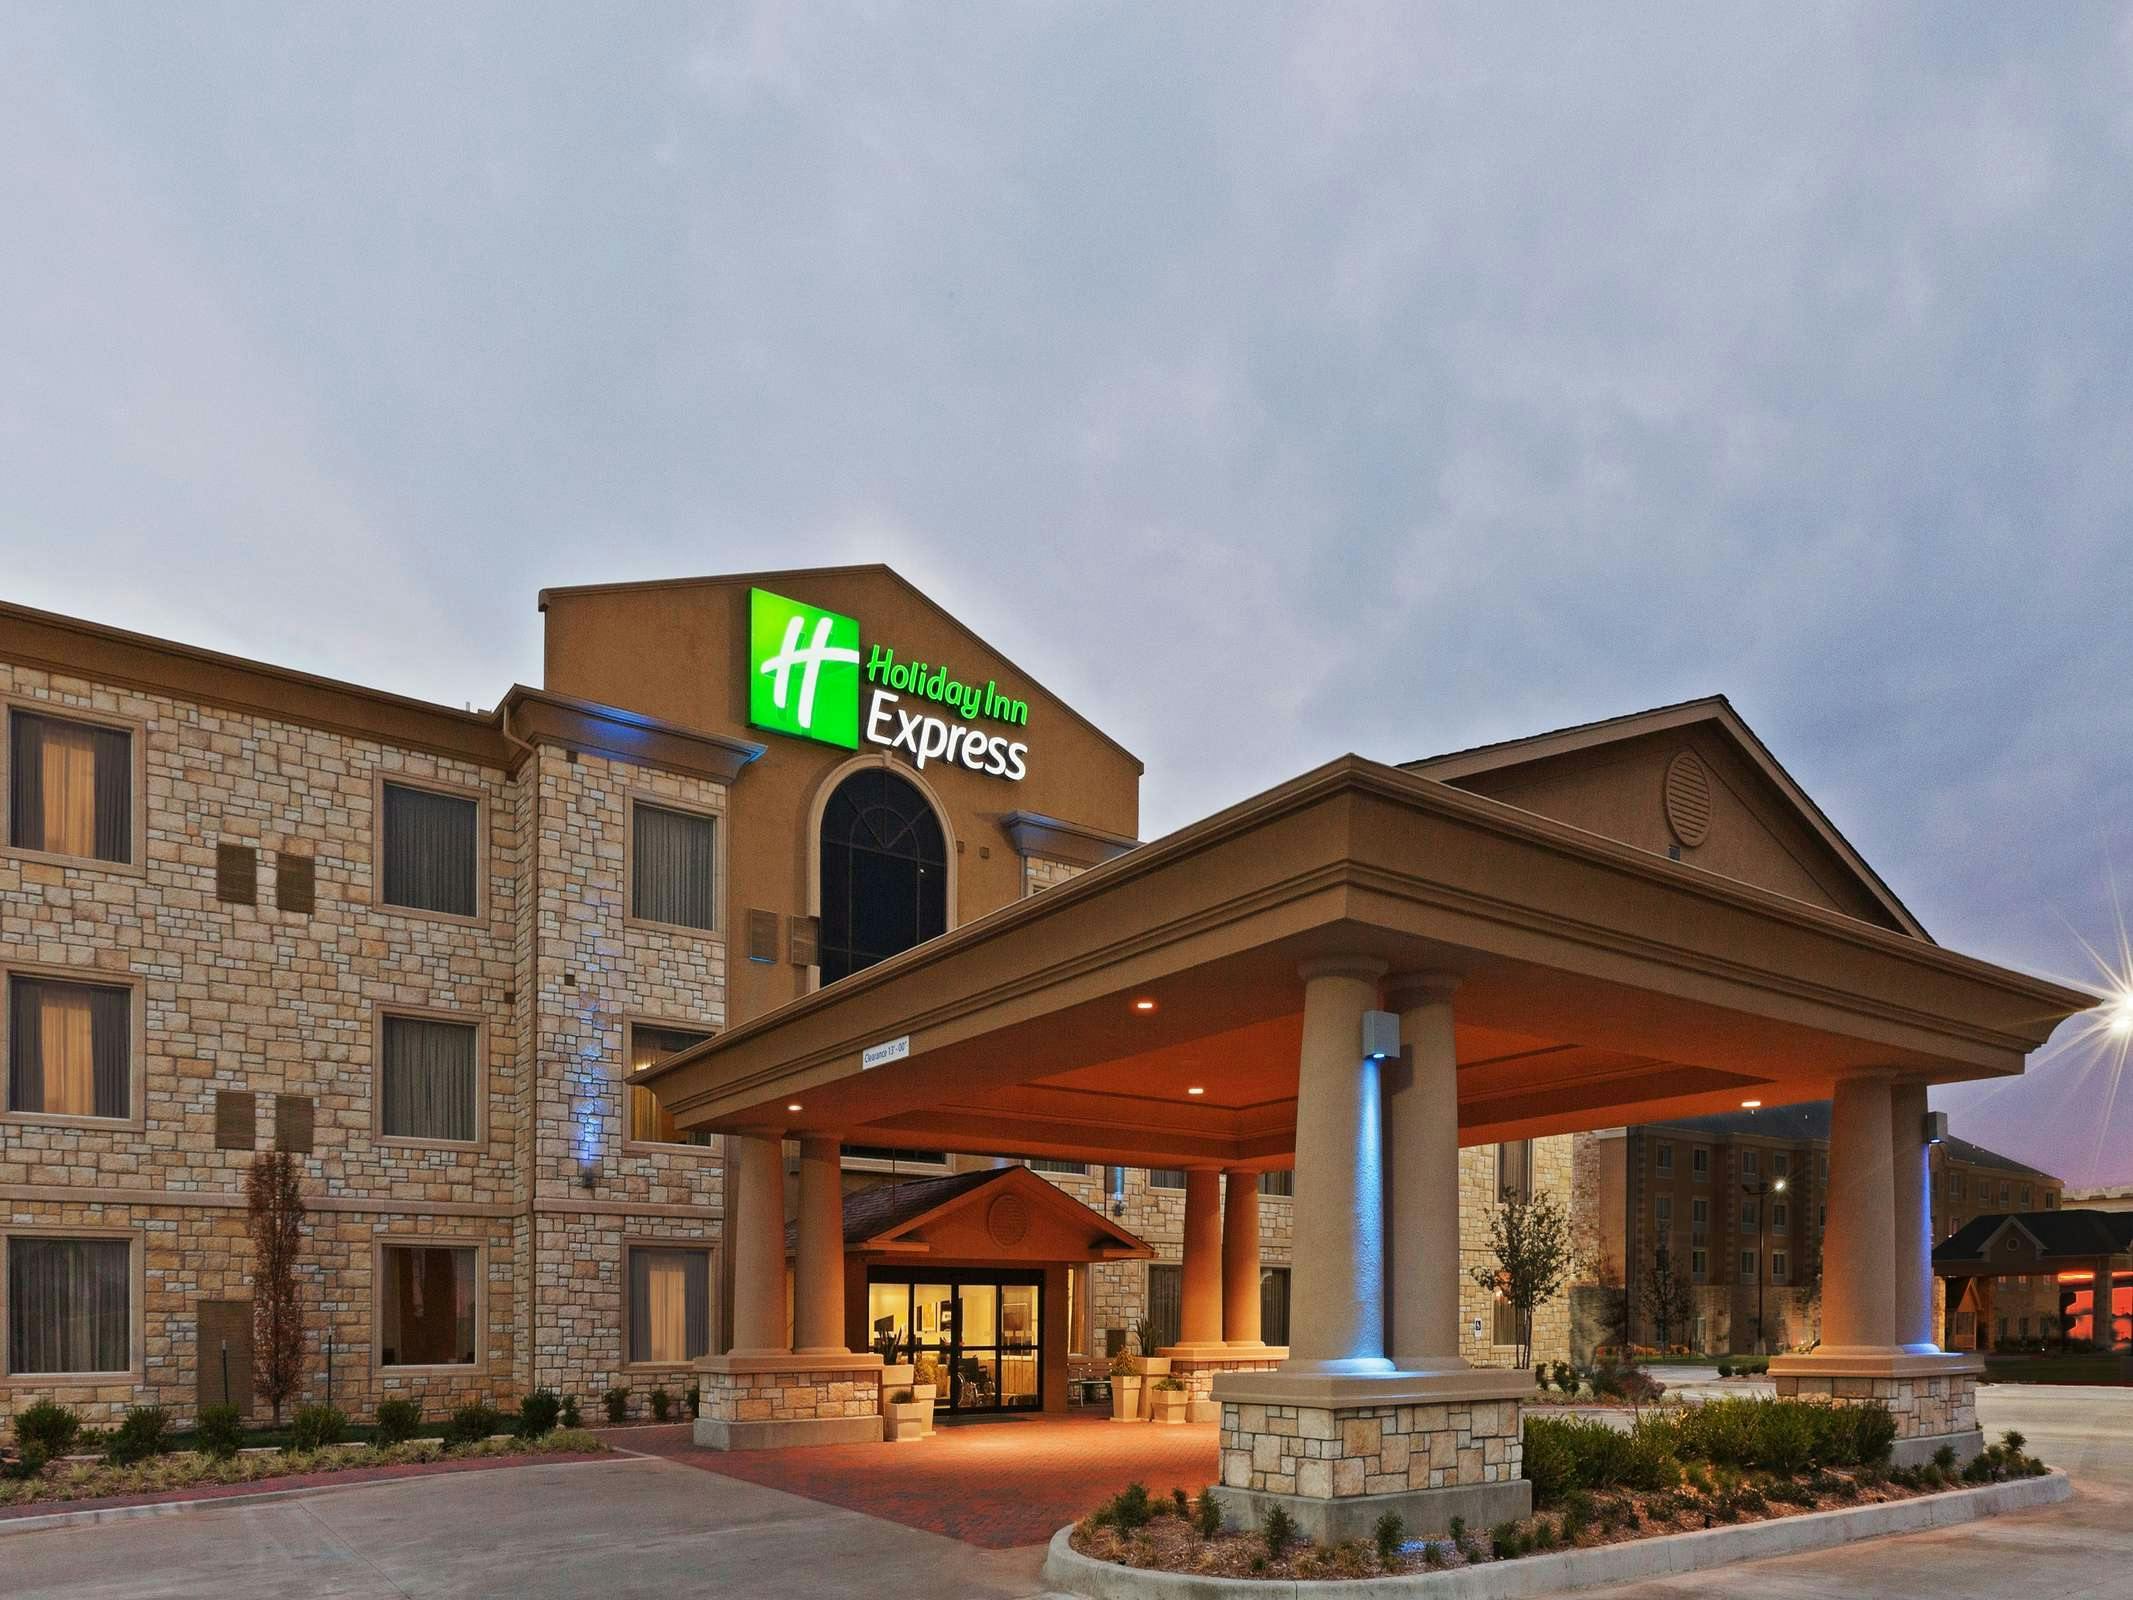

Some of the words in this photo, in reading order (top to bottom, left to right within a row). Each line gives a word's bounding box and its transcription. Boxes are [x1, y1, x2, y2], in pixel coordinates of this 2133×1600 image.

[866, 643, 983, 720] Holiday
[984, 680, 1029, 726] Inn
[866, 688, 1029, 782] Express
